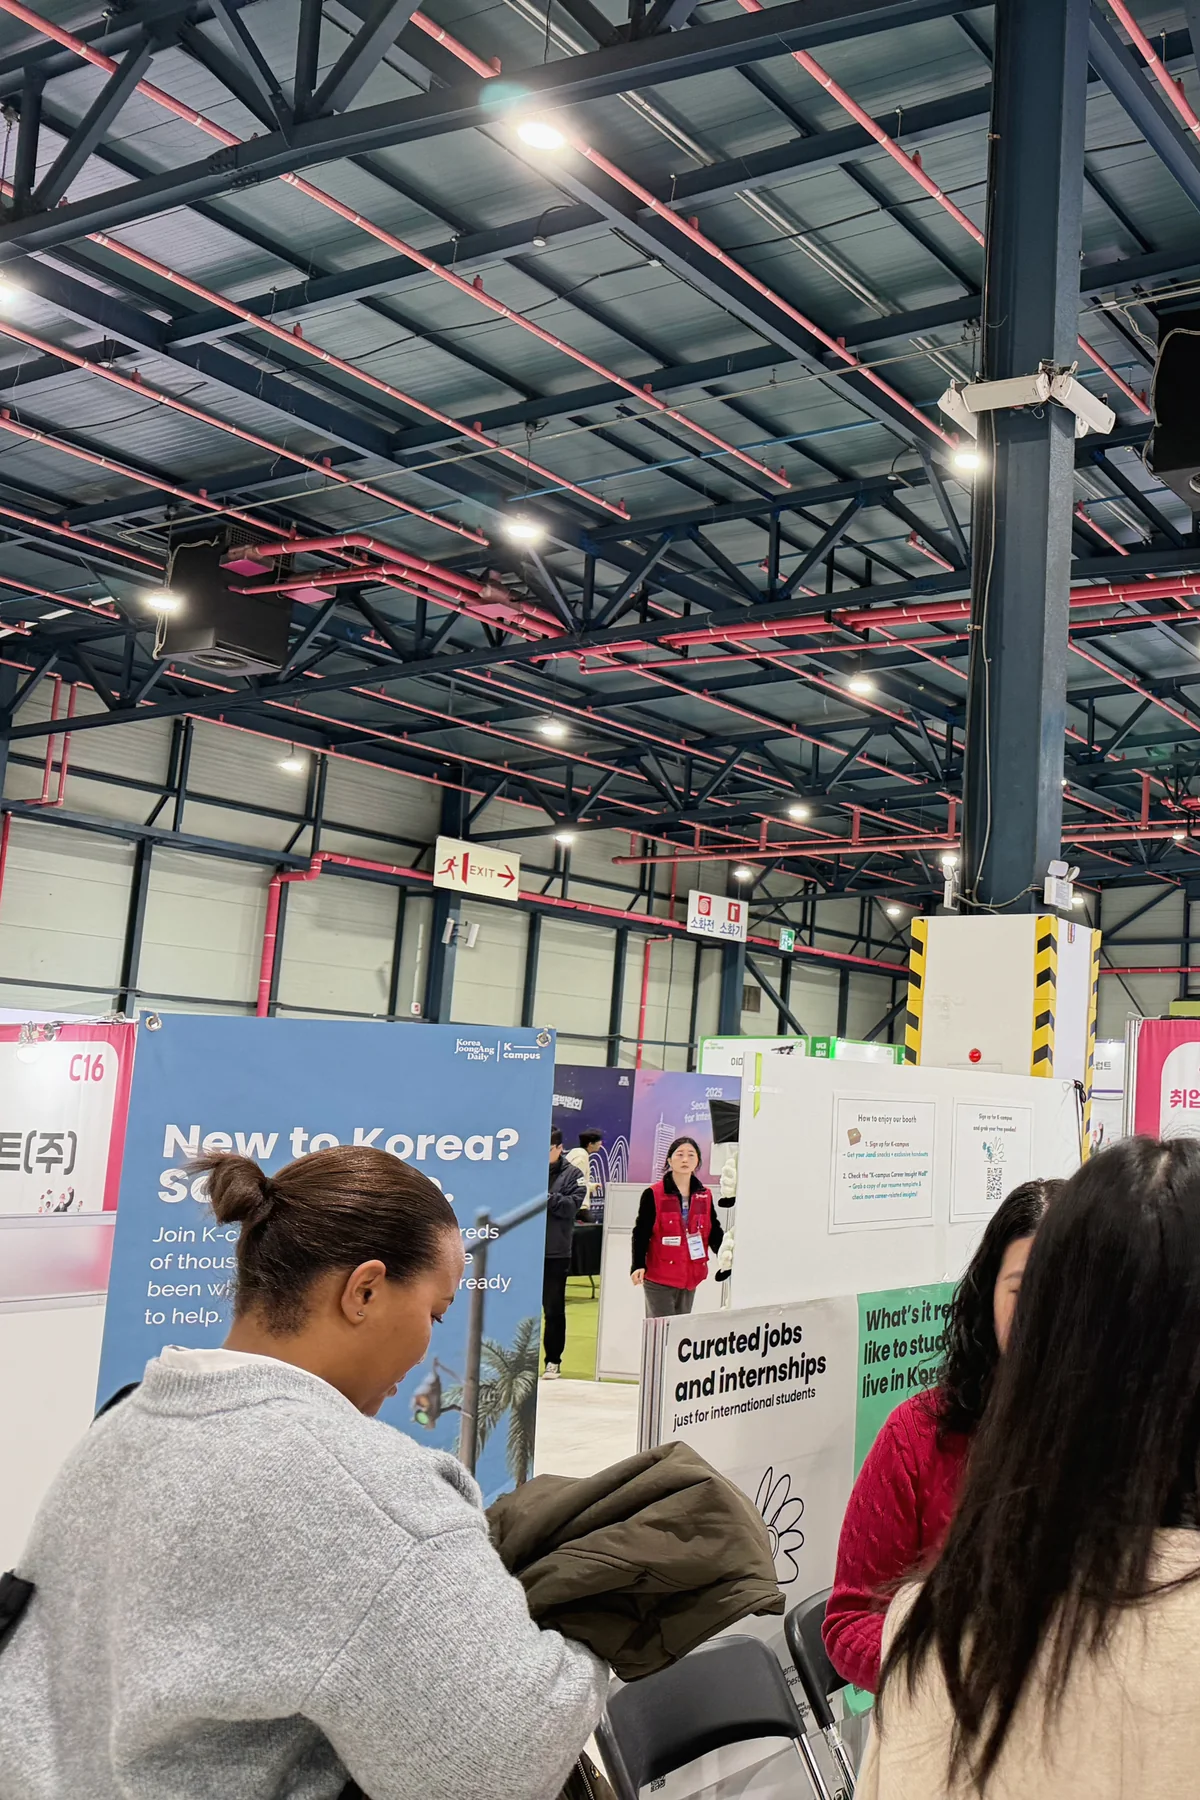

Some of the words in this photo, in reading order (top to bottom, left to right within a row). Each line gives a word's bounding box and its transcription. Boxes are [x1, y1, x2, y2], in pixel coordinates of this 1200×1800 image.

[470, 865, 495, 878] EXIT
[690, 917, 715, 932] 소화전
[719, 922, 743, 938] 소화기
[454, 1044, 495, 1055] JoongAng
[456, 1039, 481, 1047] Korea
[467, 1052, 490, 1062] Daily
[503, 1052, 540, 1061] campus
[69, 1054, 104, 1082] C16
[705, 1087, 723, 1097] 2025
[858, 1114, 870, 1122] How
[878, 1115, 892, 1124] enjoy
[902, 1115, 917, 1123] booth
[163, 1124, 279, 1159] New
[289, 1127, 341, 1159] to
[352, 1127, 520, 1160] Korea?
[152, 1226, 195, 1243] Join
[459, 1224, 499, 1239] reds
[150, 1253, 173, 1270] of
[178, 1253, 238, 1269] thous
[147, 1280, 201, 1297] been
[459, 1274, 511, 1293] ready
[144, 1308, 165, 1325] to
[171, 1307, 223, 1327] help.
[922, 1300, 931, 1322] it
[934, 1303, 951, 1320] re
[677, 1326, 761, 1363] Curated
[761, 1322, 802, 1357] jobs
[864, 1340, 890, 1365] like
[893, 1338, 907, 1358] to
[909, 1330, 946, 1355] stud
[675, 1371, 715, 1402] and
[719, 1352, 827, 1394] internships
[862, 1373, 888, 1398] live
[891, 1367, 904, 1391] in
[673, 1414, 693, 1432] just
[695, 1409, 709, 1423] for
[711, 1394, 774, 1420] international
[776, 1387, 816, 1405] students
